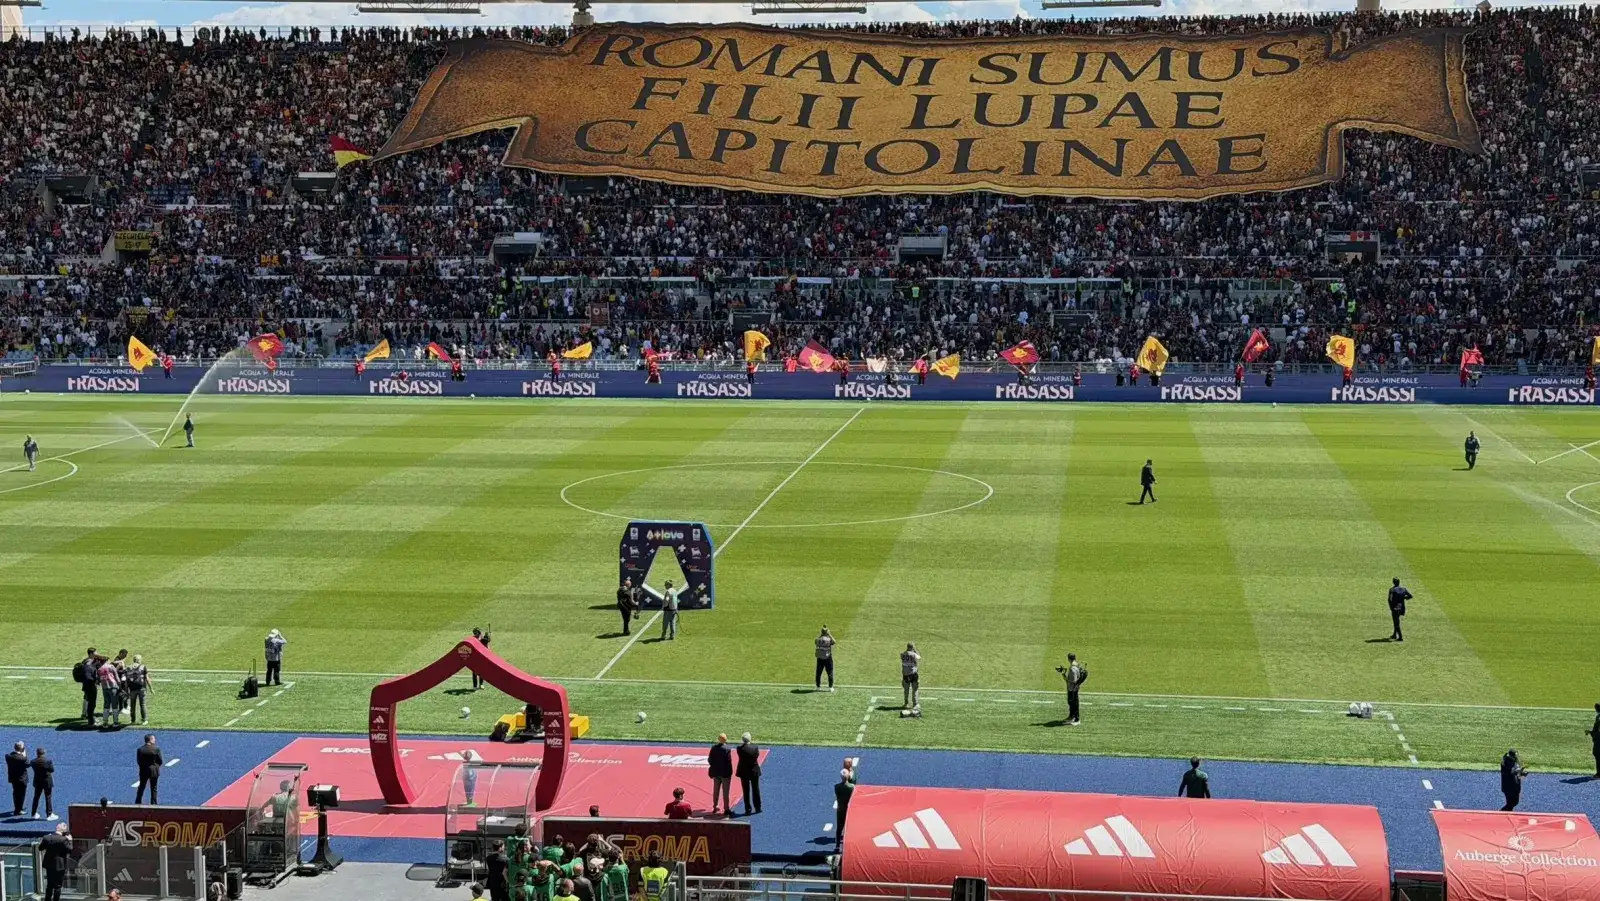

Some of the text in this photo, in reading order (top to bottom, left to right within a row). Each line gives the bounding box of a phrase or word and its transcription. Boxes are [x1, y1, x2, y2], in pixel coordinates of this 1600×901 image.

[588, 33, 1300, 87] ROMANI SUMUS
[630, 76, 1226, 131] FILII LUPAE
[575, 119, 1268, 176] CAPITOLINAE
[68, 375, 139, 391] FRASASSI
[218, 377, 290, 393] FRASASSI
[369, 378, 442, 394] FRASASSI
[522, 380, 595, 395] FRASASSI
[677, 381, 751, 397] FRASASSI
[835, 382, 911, 398] FRASASSI
[996, 383, 1073, 399] FRASASSI
[1161, 384, 1241, 400] FRASASSI
[1331, 385, 1415, 401] FRASASSI
[1508, 386, 1594, 403] FRASASSI
[320, 747, 415, 757] EUROT
[598, 834, 711, 863] SROMA
[1453, 850, 1598, 868] Auberge Collection
